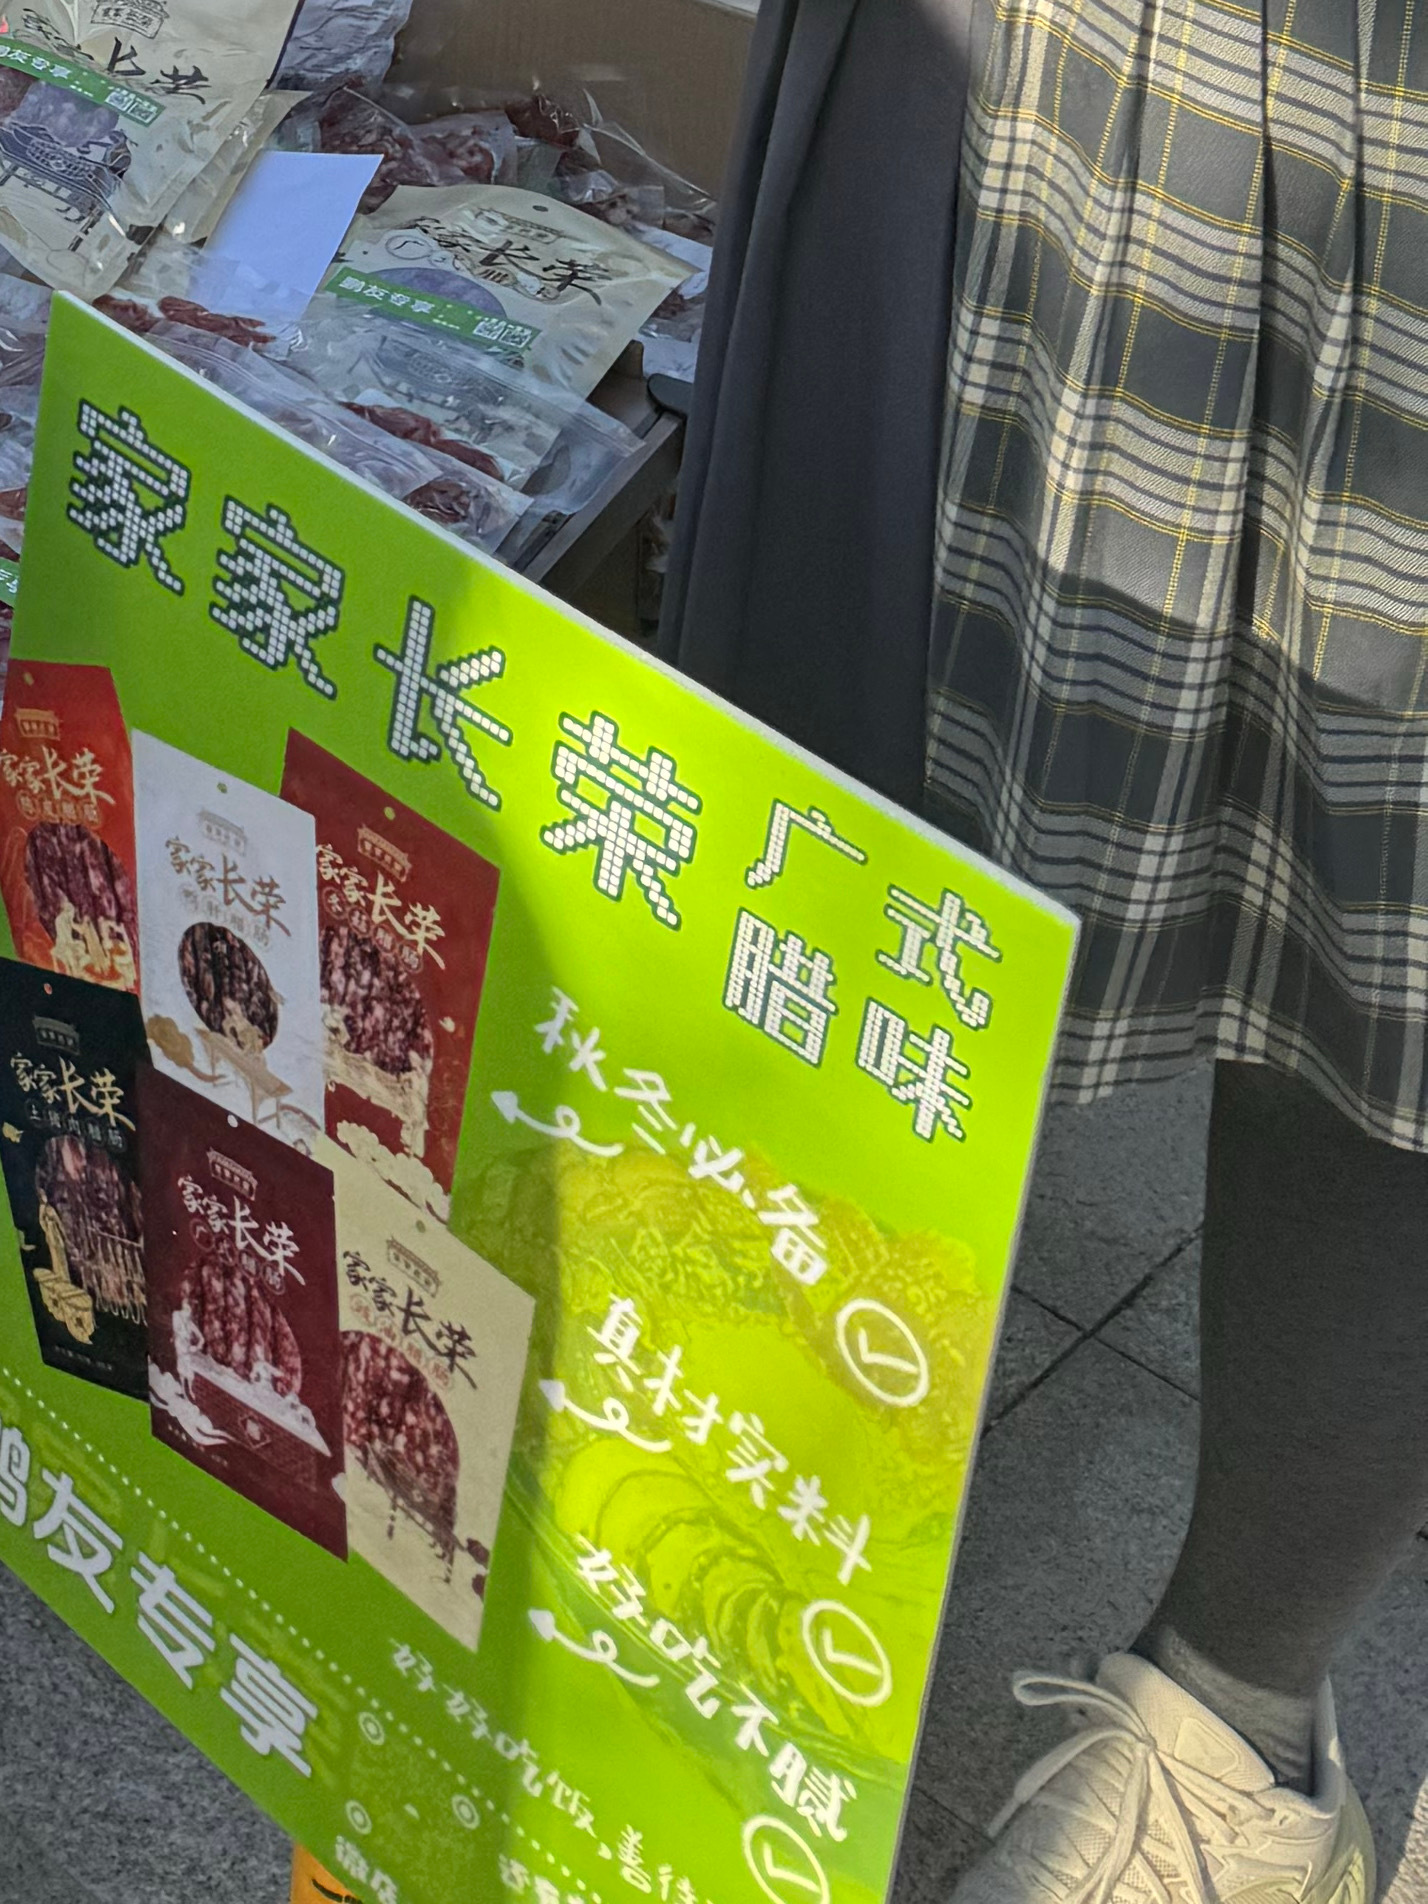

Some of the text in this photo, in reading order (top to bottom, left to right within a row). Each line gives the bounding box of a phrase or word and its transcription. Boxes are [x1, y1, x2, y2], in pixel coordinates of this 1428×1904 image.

[66, 399, 702, 929] 家家长荣
[164, 835, 292, 938] 家家长荣
[315, 842, 446, 971] 家家长荣
[742, 796, 1002, 1030] 广式
[10, 1051, 137, 1132] 家家长荣
[534, 986, 829, 1286] 秋冬必备
[721, 904, 971, 1142] 腊味
[177, 1173, 307, 1287] 家家长荣
[342, 1249, 479, 1392] 家家长荣
[587, 1292, 872, 1586] 真材实料
[575, 1532, 857, 1843] 好吃不腻
